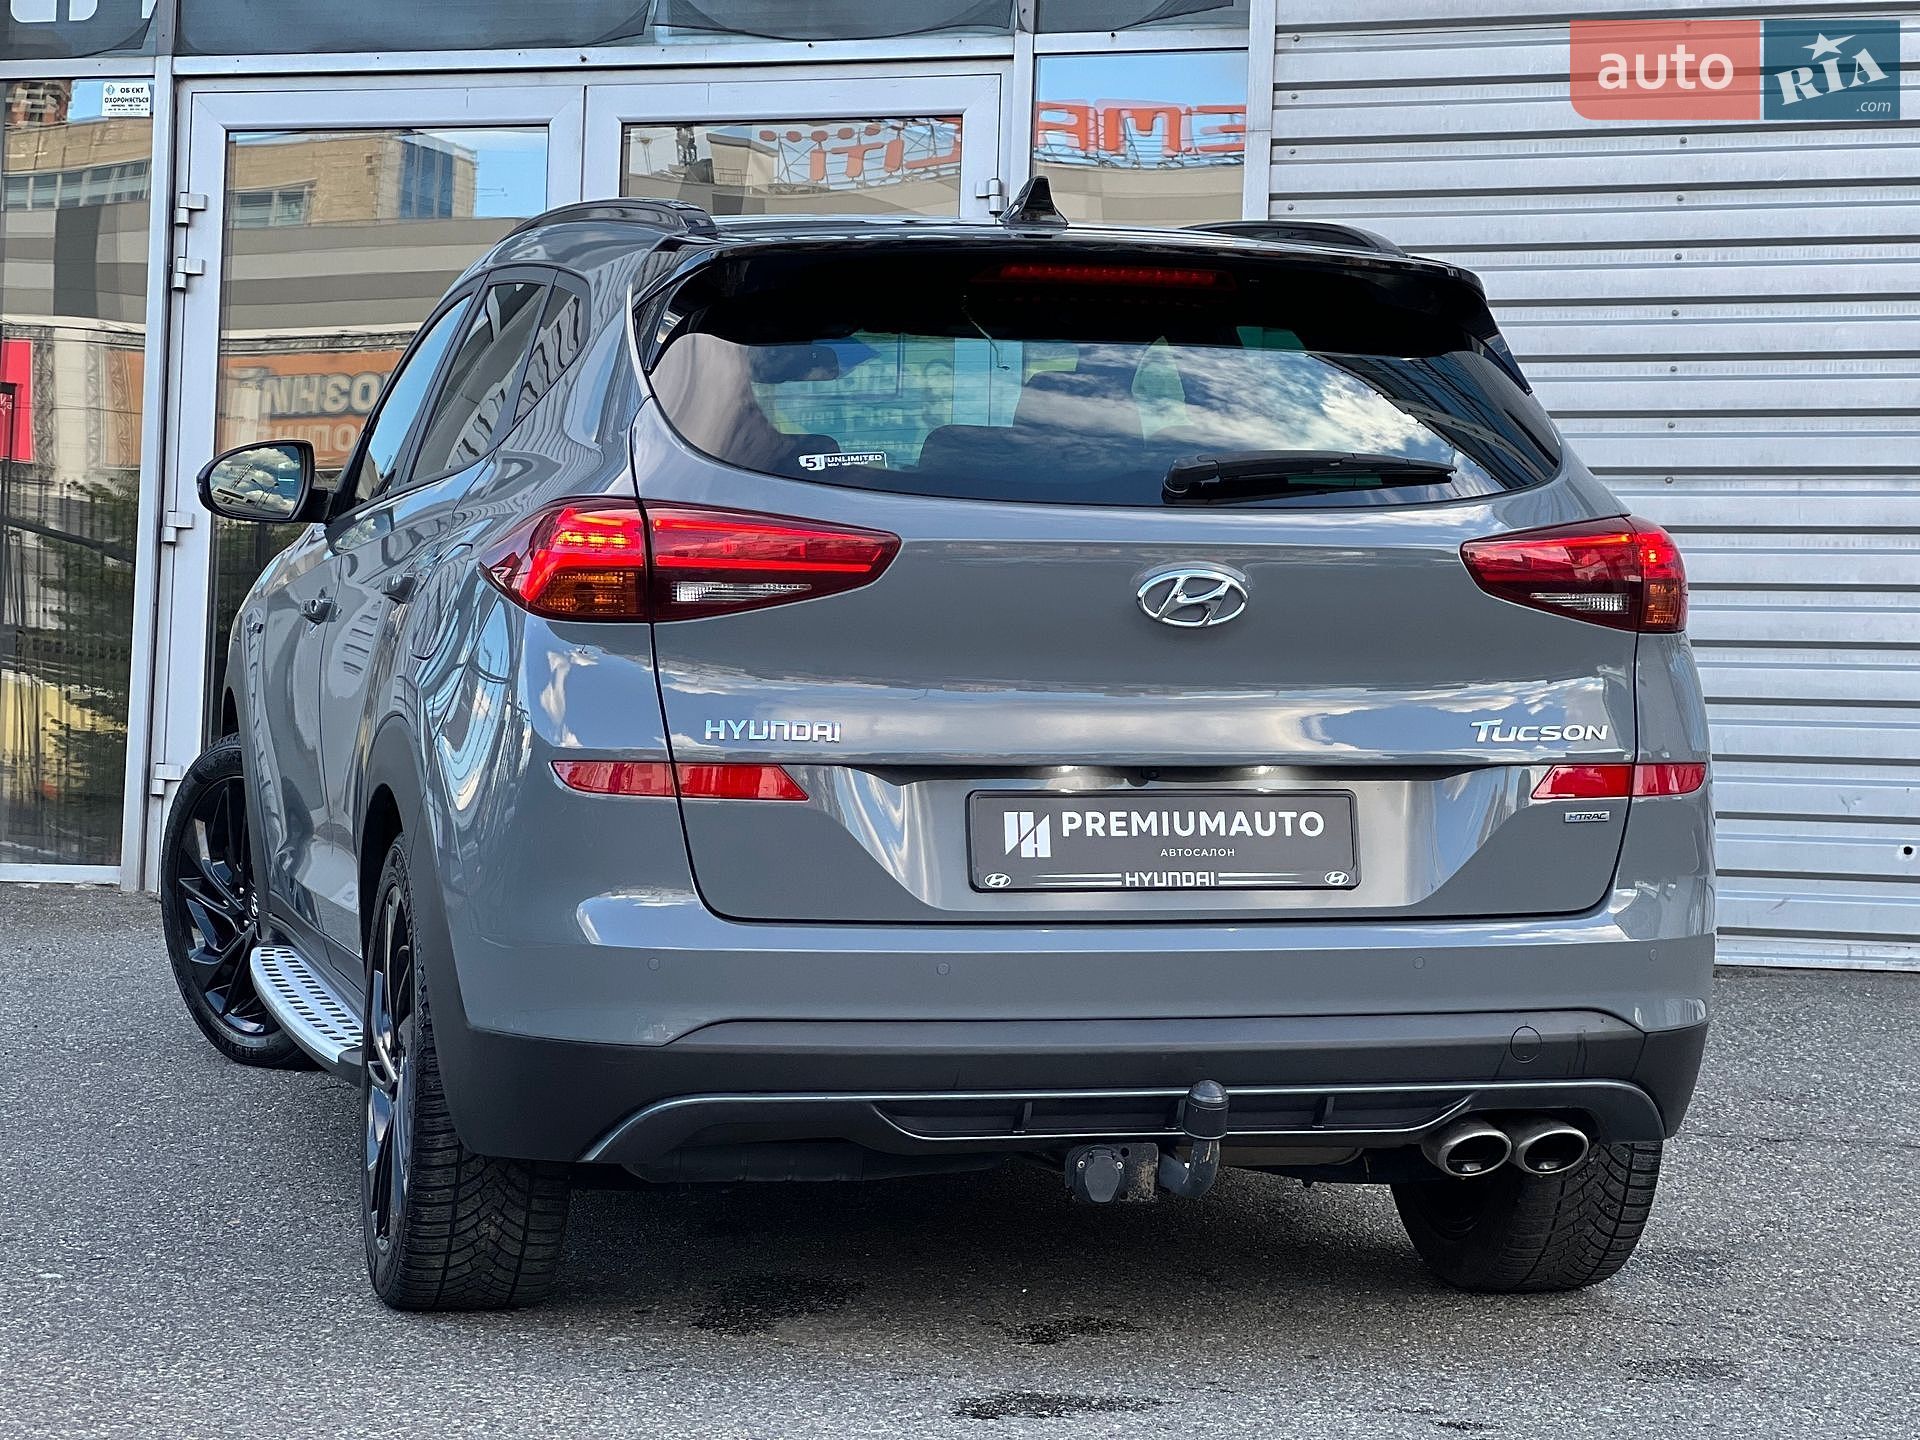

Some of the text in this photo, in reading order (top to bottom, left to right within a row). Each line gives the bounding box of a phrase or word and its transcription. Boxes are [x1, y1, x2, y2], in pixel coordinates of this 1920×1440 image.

[827, 454, 883, 463] UNLIMITED
[704, 719, 842, 743] HYUNDAI
[1567, 812, 1609, 821] HTRAC
[1061, 810, 1325, 838] PREMIUMAUTO
[1159, 847, 1236, 857] АВТОСАЛОН
[1125, 871, 1216, 887] HYUNDAI
